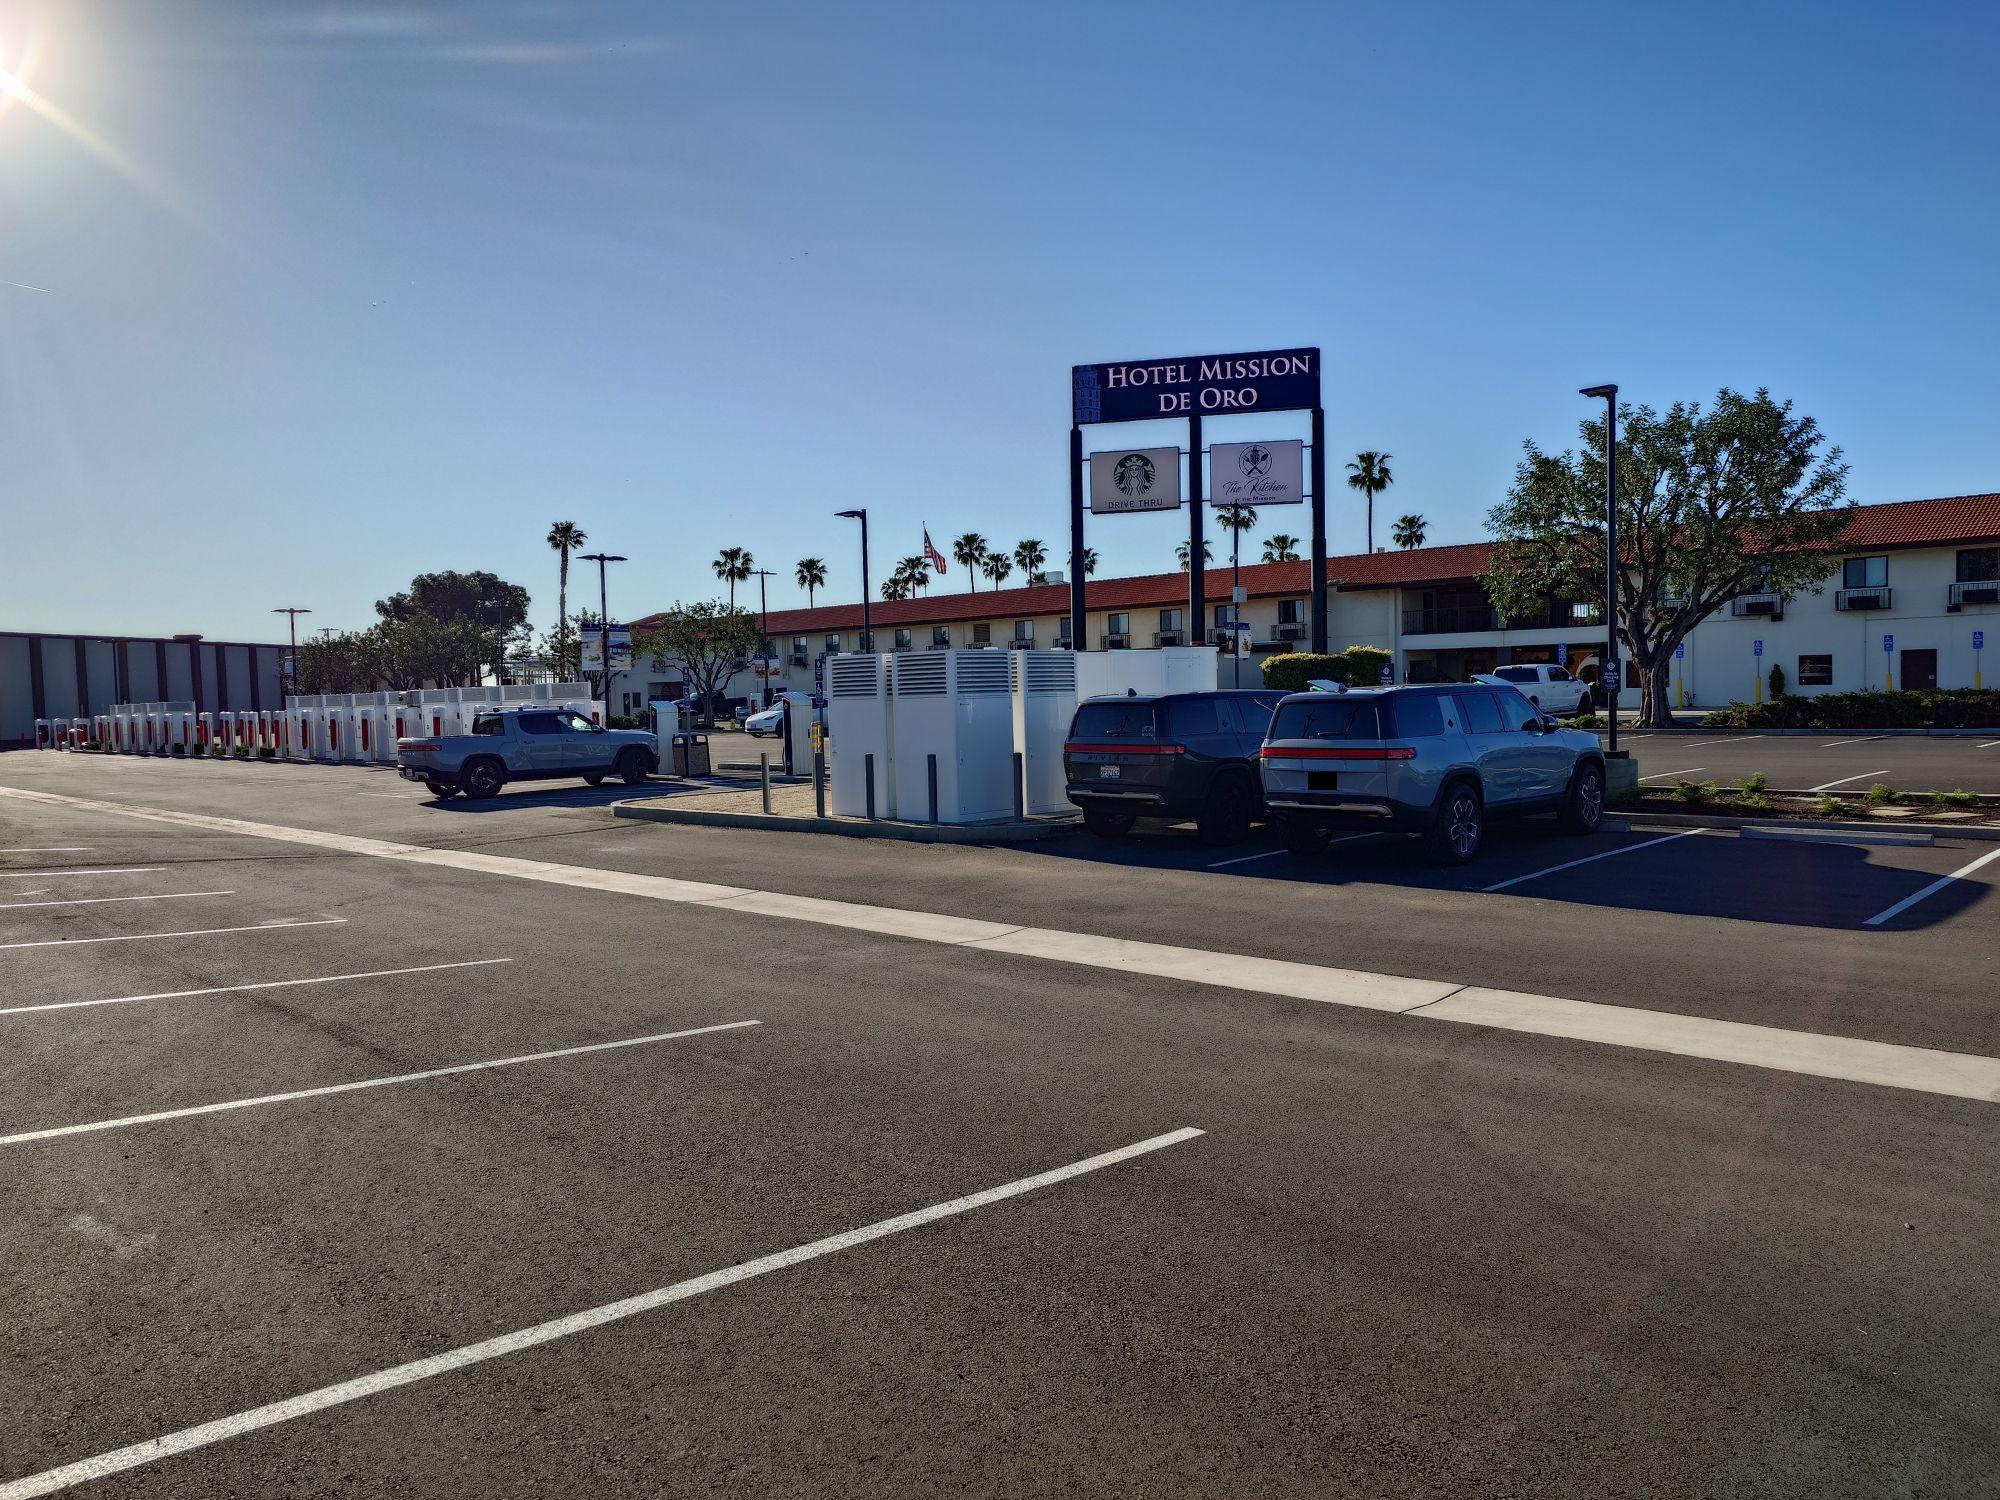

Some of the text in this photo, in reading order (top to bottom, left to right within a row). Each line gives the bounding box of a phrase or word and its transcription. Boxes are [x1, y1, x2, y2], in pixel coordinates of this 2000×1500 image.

[1107, 355, 1310, 388] HOTEL MISSION
[1159, 388, 1258, 411] DE ORO
[1223, 477, 1287, 496] The Kitchen
[1108, 499, 1162, 509] DRIVE THRU
